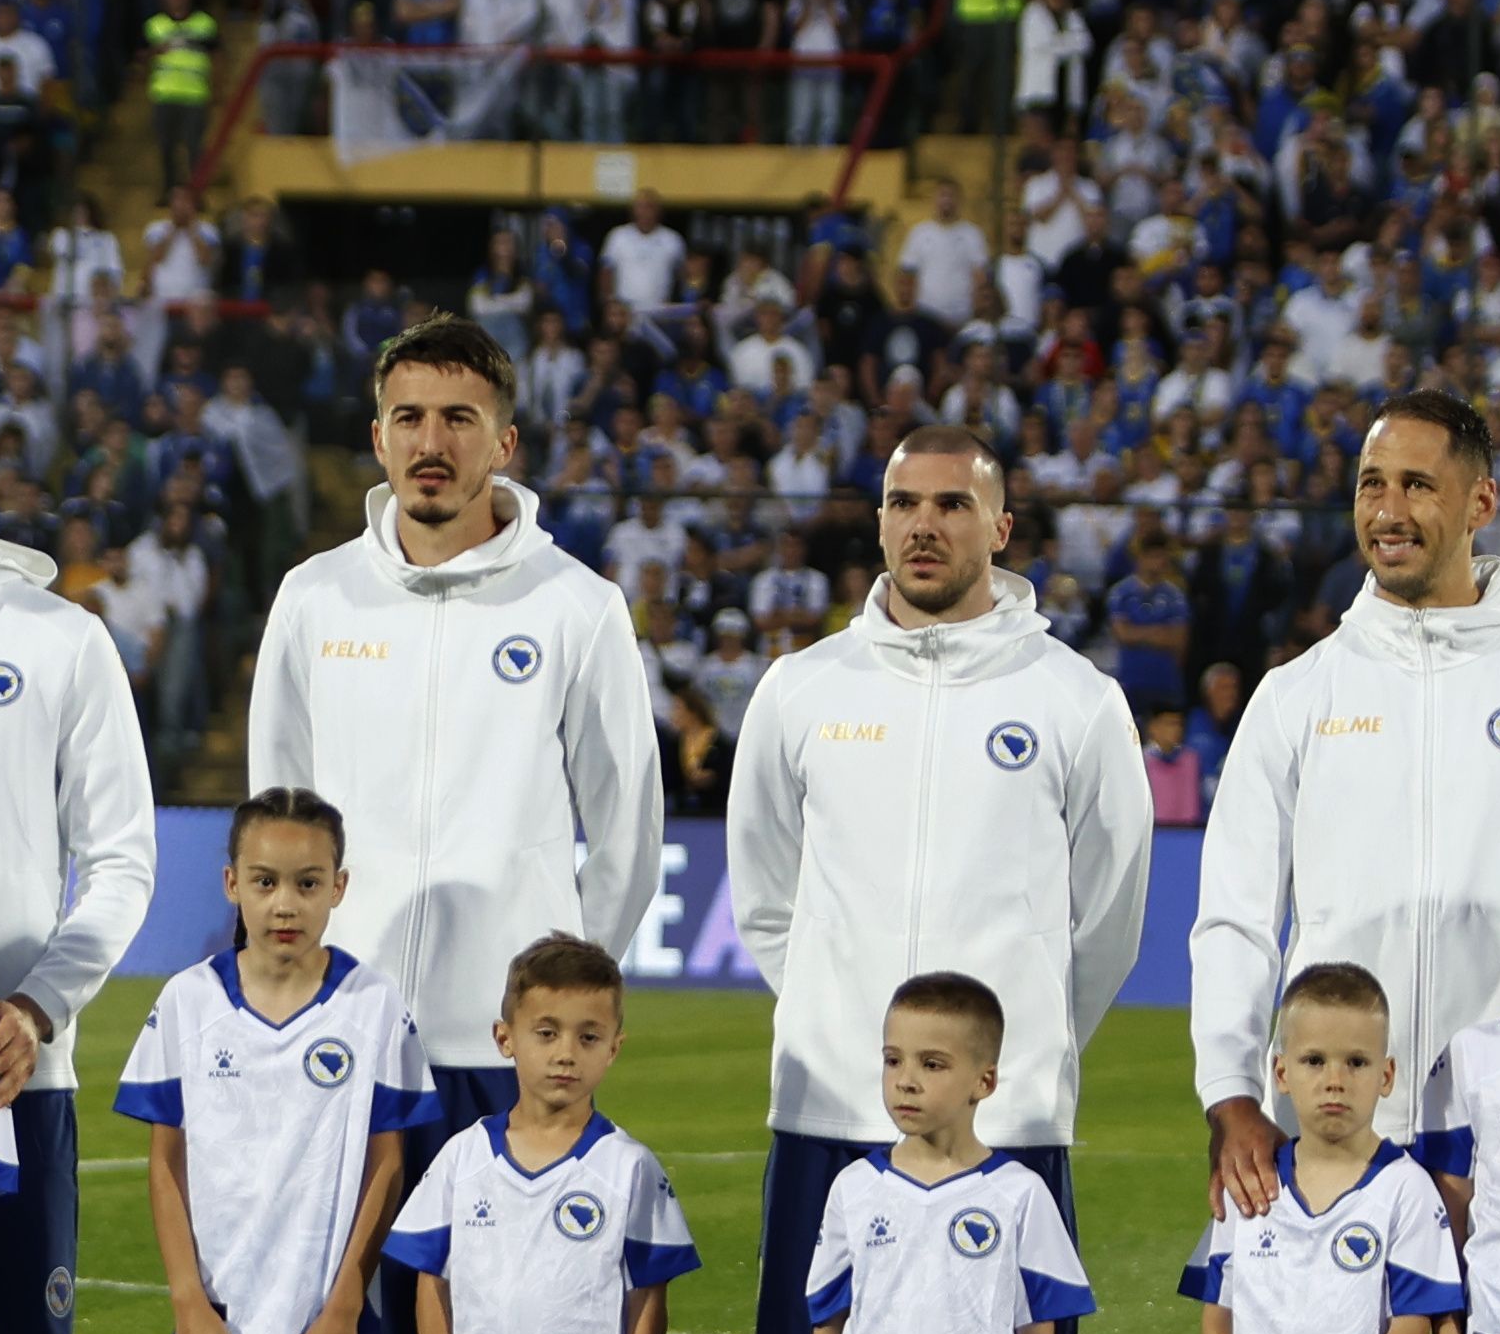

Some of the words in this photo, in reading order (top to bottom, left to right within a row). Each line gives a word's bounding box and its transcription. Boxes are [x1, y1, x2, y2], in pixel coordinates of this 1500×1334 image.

[321, 641, 391, 659] KELME
[819, 722, 888, 741] KELME
[1316, 716, 1383, 736] KELME
[208, 1069, 241, 1079] KELME
